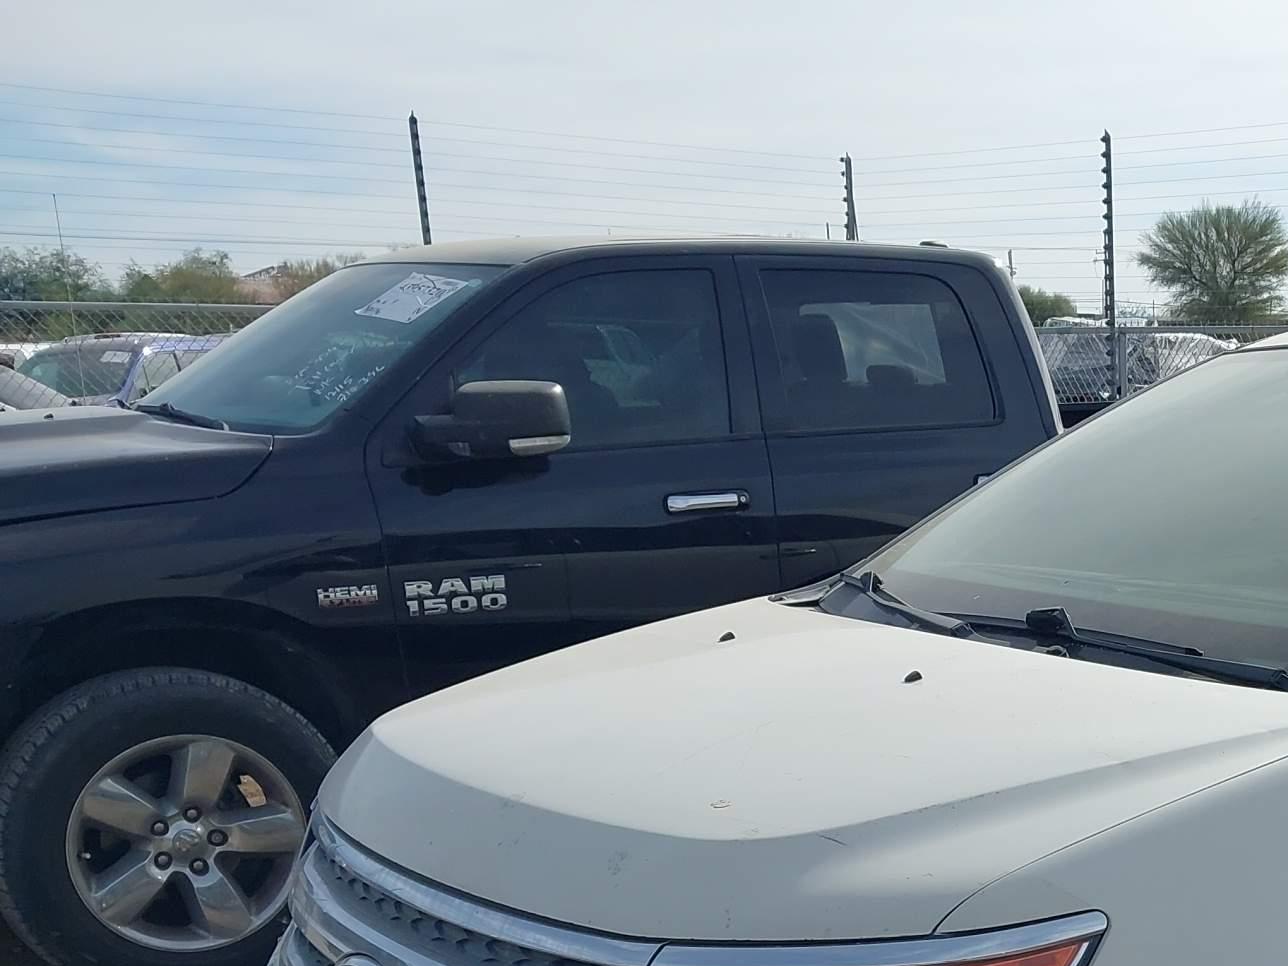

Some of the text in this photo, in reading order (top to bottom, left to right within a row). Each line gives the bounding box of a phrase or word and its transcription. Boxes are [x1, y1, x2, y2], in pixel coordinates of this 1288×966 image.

[317, 585, 378, 601] HEMI
[404, 574, 506, 598] RAM
[406, 593, 508, 617] 1500
